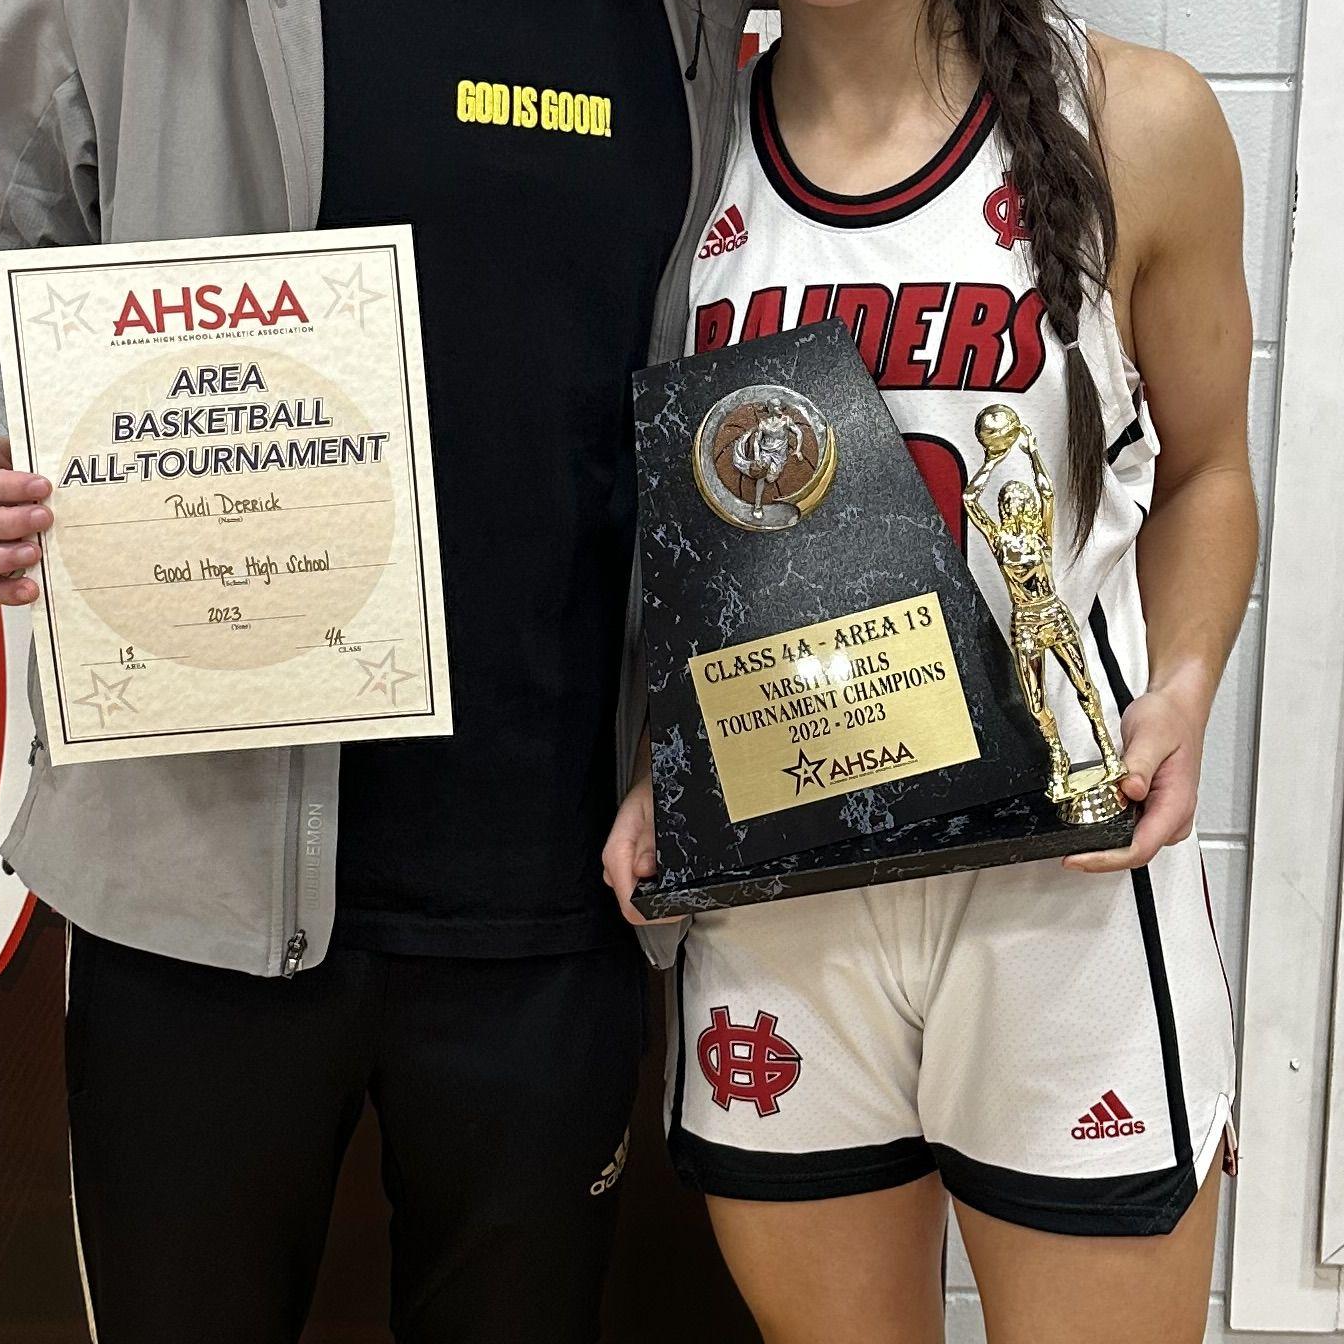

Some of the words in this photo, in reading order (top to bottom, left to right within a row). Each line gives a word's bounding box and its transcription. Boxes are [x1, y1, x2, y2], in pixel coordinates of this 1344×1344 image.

[457, 80, 510, 125] GOD
[513, 86, 538, 128] IS
[541, 89, 612, 137] GOOD!
[113, 280, 310, 336] AHSAA
[110, 338, 151, 347] ALABAMA
[153, 336, 175, 344] HIGH
[178, 333, 213, 342] SCHOOL
[215, 329, 255, 339] ATHLETIC
[257, 325, 315, 337] ASSOCIATION
[166, 362, 269, 399] AREA
[112, 398, 334, 443] BASKETBALL
[59, 432, 390, 488] ALL-TOURNAMENT
[164, 494, 210, 518] Rudi
[154, 560, 192, 583] Good
[200, 558, 234, 587] Hope
[246, 555, 278, 585] High
[286, 550, 330, 573] School
[208, 606, 242, 623] 2023
[325, 627, 346, 646] 4A
[338, 644, 361, 654] CLASS
[704, 648, 776, 684] CLASS
[782, 639, 814, 664] 4A
[834, 616, 900, 650] AREA
[904, 606, 933, 631] 13
[717, 689, 838, 738] TOURNAMENT
[843, 661, 946, 704] CHAMPIONS
[789, 718, 831, 743] 2022
[844, 703, 886, 730] 2023
[830, 742, 915, 780] AHSAA
[1071, 1120, 1146, 1140] adidas
